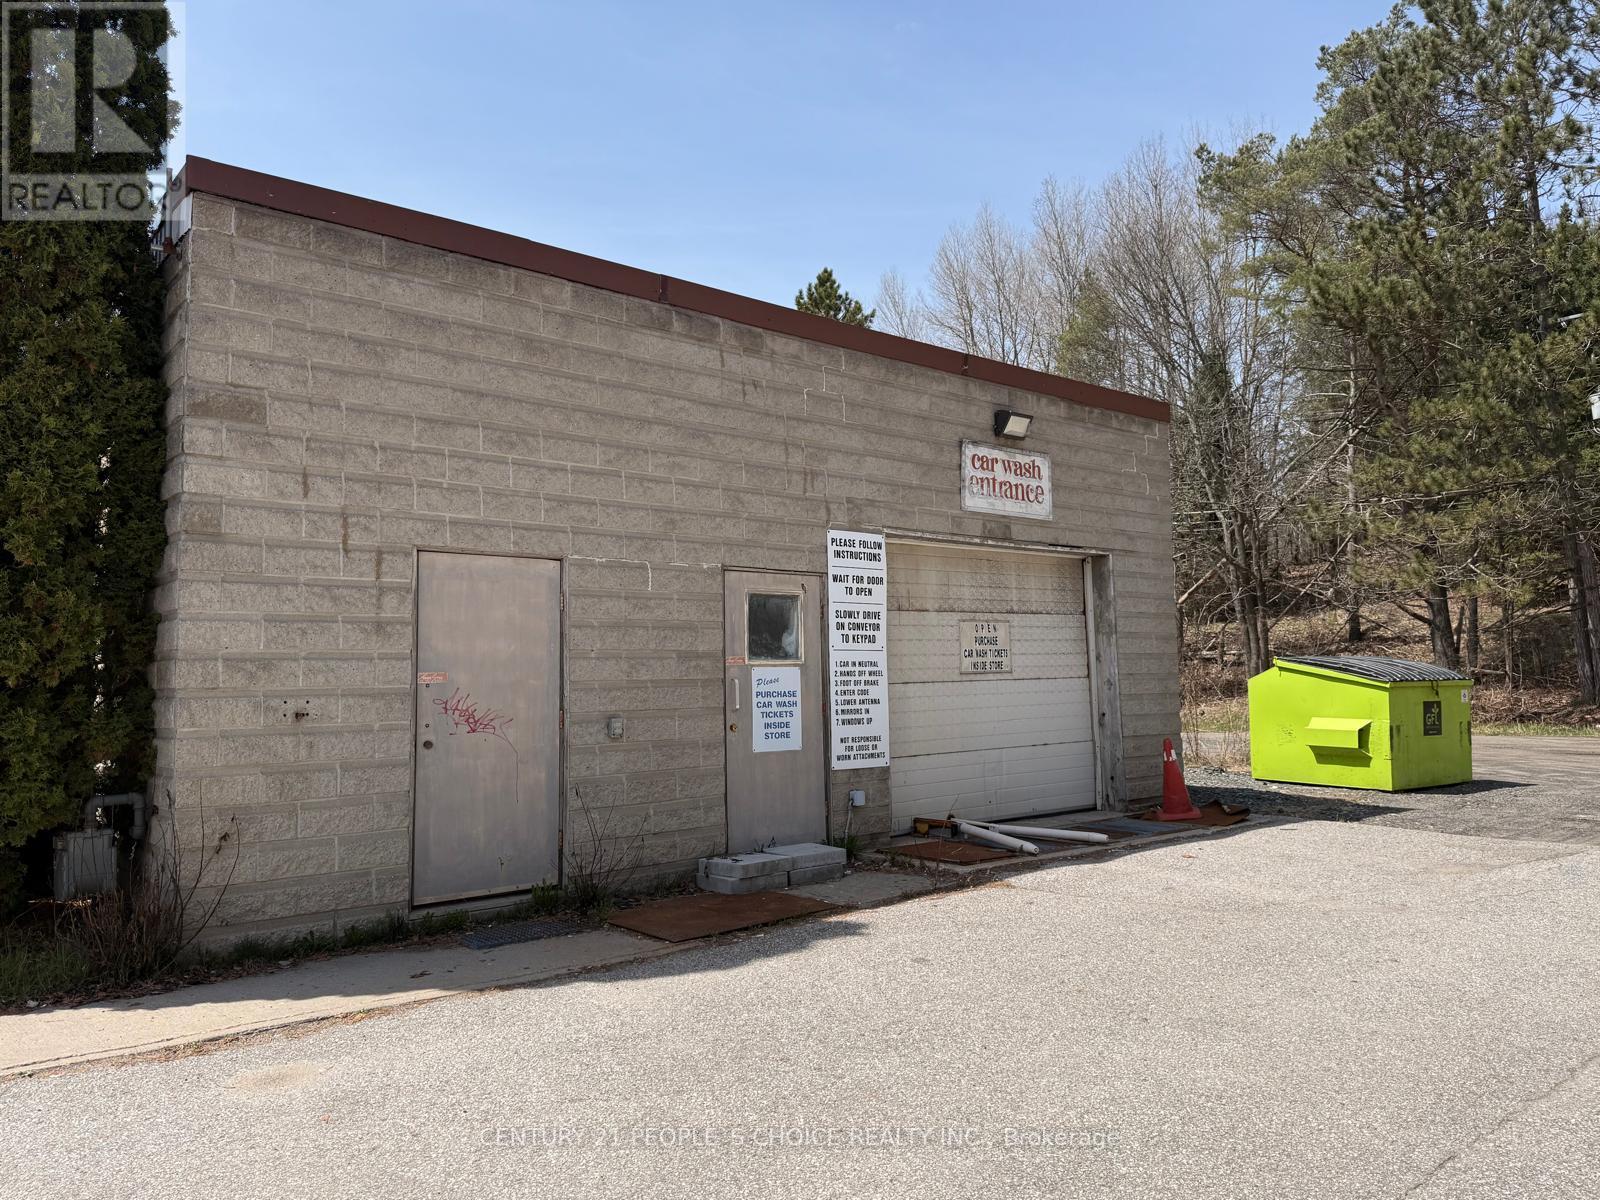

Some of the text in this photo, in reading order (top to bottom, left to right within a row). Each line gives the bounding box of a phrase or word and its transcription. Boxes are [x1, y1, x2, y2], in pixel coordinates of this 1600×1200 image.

[971, 453, 1043, 481] car wash
[968, 474, 1045, 504] entrance
[831, 537, 882, 550] PLEASE FOLLOW
[834, 550, 881, 562] INSTRUCTIONS
[832, 574, 884, 585] WAIT FOR DOOR
[845, 586, 872, 596] TO OPEN
[835, 610, 881, 620] SLOWLY DRIVE
[836, 622, 880, 631] ON CONVEYOR
[841, 634, 876, 644] TO KEYPAD
[974, 636, 998, 646] PURCHASE
[964, 649, 1008, 658] CAR WASH TICKETS
[970, 660, 1003, 670] INSIDE STORE
[756, 677, 780, 688] Please
[755, 690, 797, 698] PURCHASE
[775, 700, 798, 708] WASH
[761, 710, 794, 718] TICKETS
[1426, 713, 1439, 725] GFL
[764, 721, 790, 729] INSIDE
[866, 717, 872, 725] UP
[764, 731, 790, 739] STORE
[851, 735, 882, 743] RESPONSIBLE
[855, 744, 870, 752] LOOSE
[853, 752, 886, 760] ATTACHMENTS
